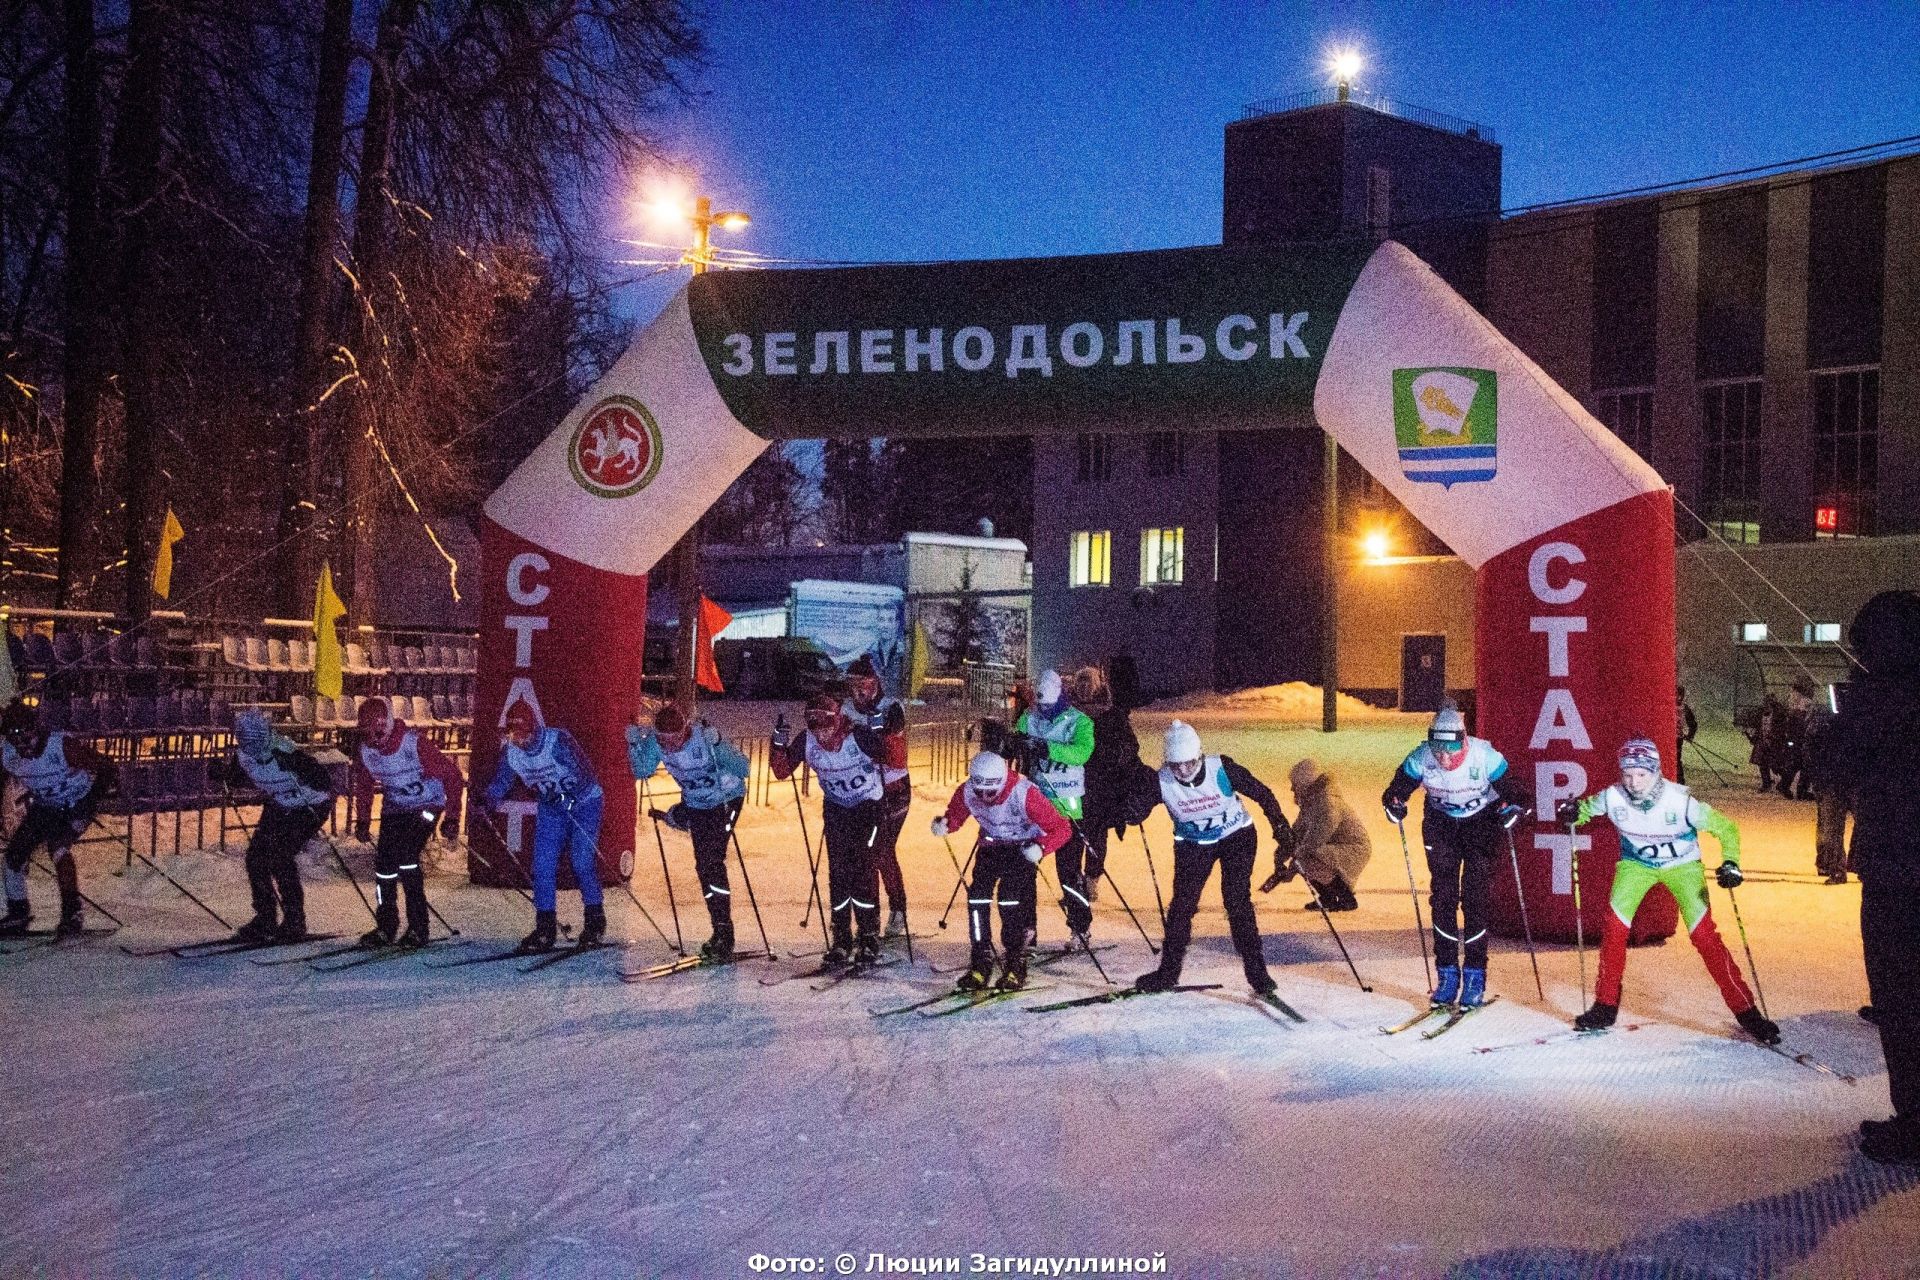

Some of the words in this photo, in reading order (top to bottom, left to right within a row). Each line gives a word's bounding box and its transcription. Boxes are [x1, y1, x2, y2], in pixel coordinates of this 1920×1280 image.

[722, 311, 1311, 378] ЗЕЛЕНОДОЛЬСК
[497, 552, 551, 851] СТАТ
[1527, 541, 1594, 894] СТАРТ
